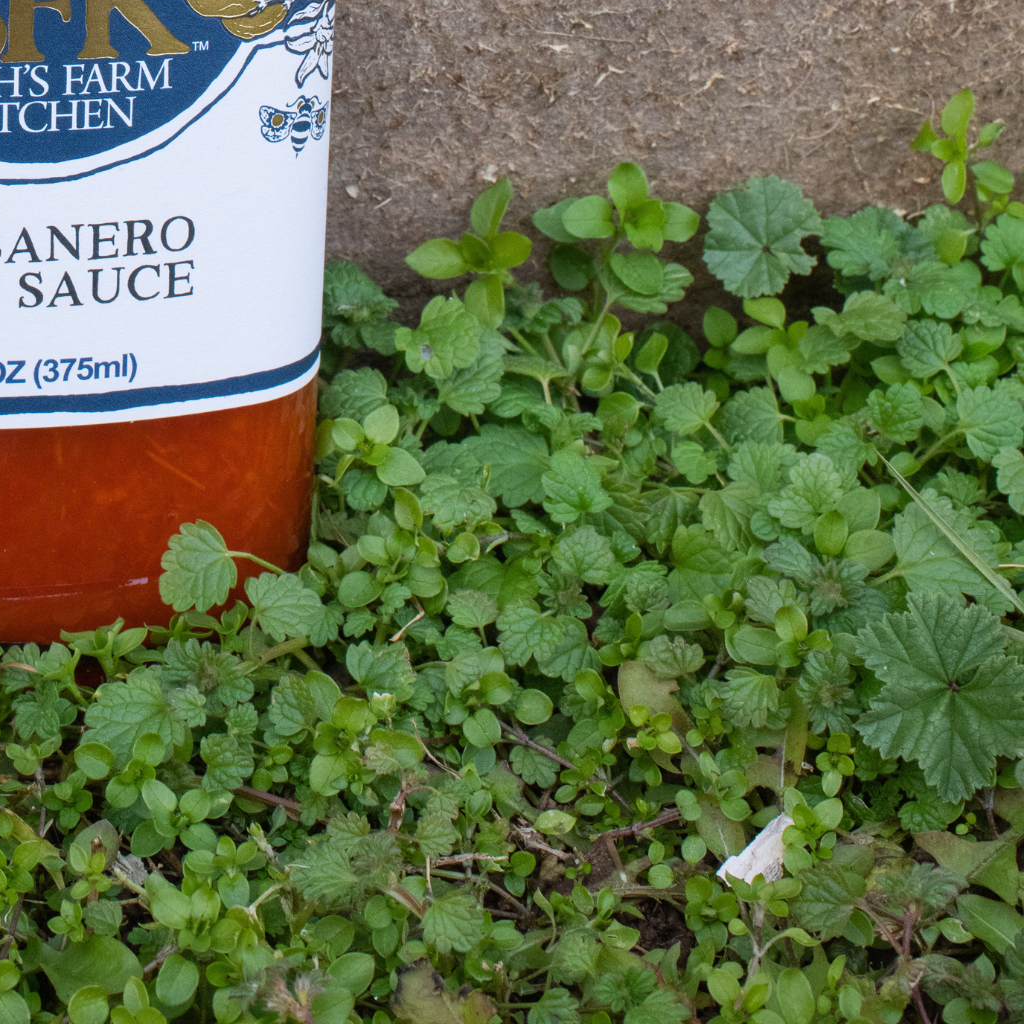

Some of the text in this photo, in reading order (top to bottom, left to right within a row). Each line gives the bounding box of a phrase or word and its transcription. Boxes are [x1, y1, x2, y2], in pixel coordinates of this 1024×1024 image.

[62, 58, 174, 95] FARM
[17, 260, 195, 309] SAUCE
[33, 352, 138, 390] (375ml)
